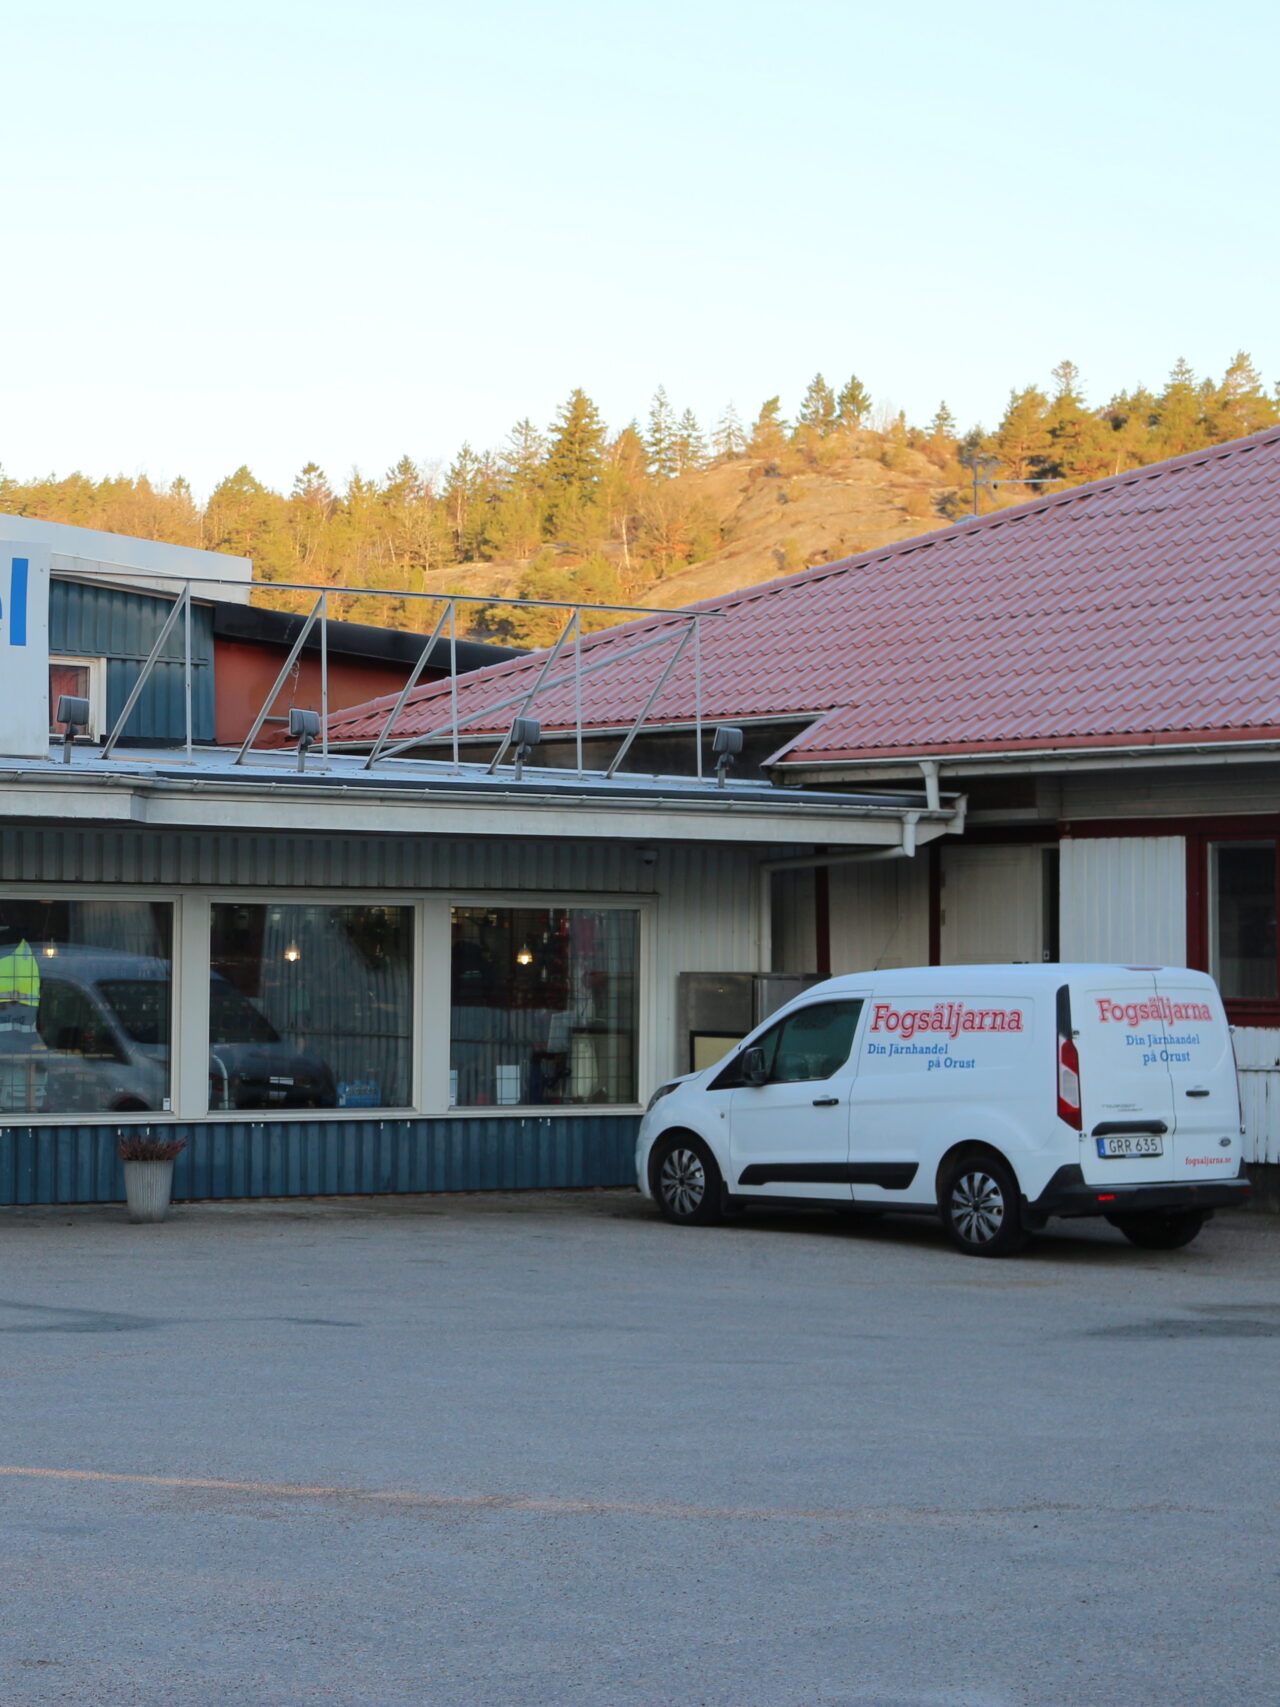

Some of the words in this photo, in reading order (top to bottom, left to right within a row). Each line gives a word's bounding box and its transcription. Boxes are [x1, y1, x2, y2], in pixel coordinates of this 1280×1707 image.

[1094, 997, 1213, 1028] Fogsäljarna
[870, 1002, 1024, 1041] Fogsäljarna
[1125, 1034, 1145, 1046] Din
[1148, 1033, 1200, 1048] Järnhandel
[867, 1043, 886, 1055] Din
[888, 1043, 949, 1057] Järnhandel
[927, 1058, 941, 1071] på
[944, 1057, 975, 1069] Orust
[1142, 1051, 1157, 1066] på
[1159, 1050, 1191, 1062] Orust
[1109, 1139, 1132, 1153] GRR
[1135, 1138, 1158, 1153] 635
